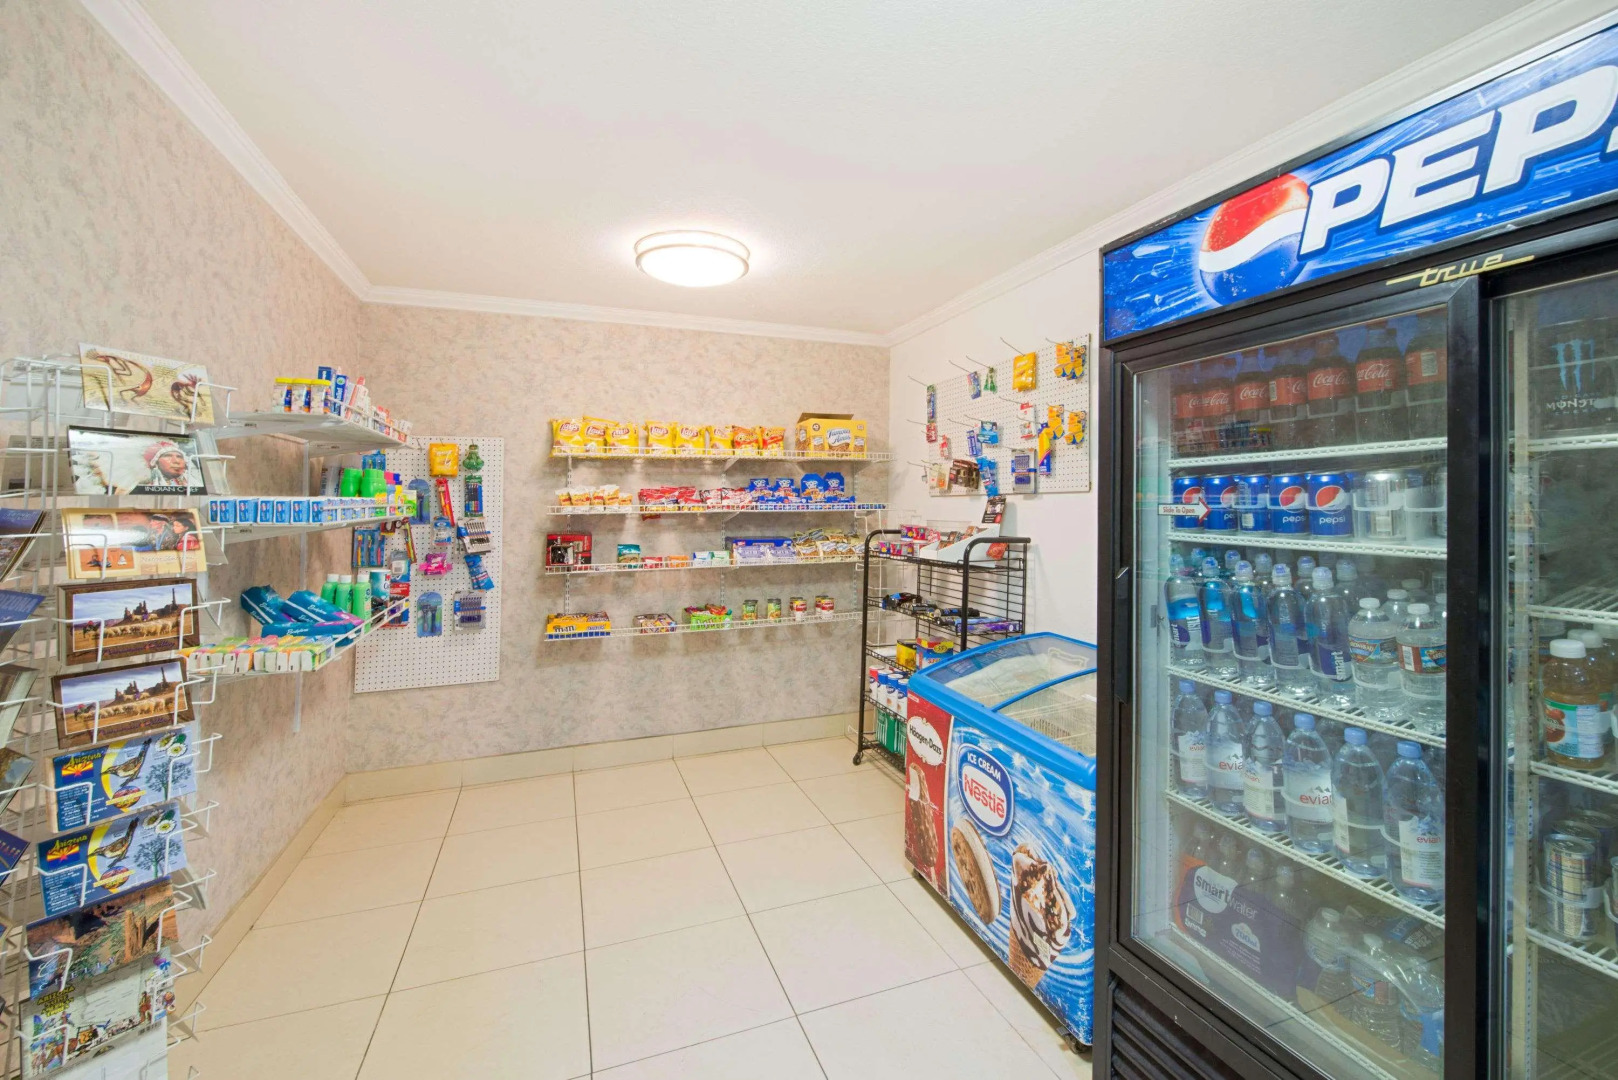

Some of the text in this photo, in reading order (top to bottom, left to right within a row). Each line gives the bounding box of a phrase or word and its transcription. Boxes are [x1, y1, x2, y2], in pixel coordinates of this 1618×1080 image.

[1300, 65, 1618, 255] PEP
[1415, 253, 1508, 287] true
[1546, 398, 1595, 410] MONST
[1181, 507, 1196, 515] Open
[1319, 516, 1346, 525] pepsi
[967, 751, 1001, 781] ICE CREAM
[1219, 761, 1243, 770] evia
